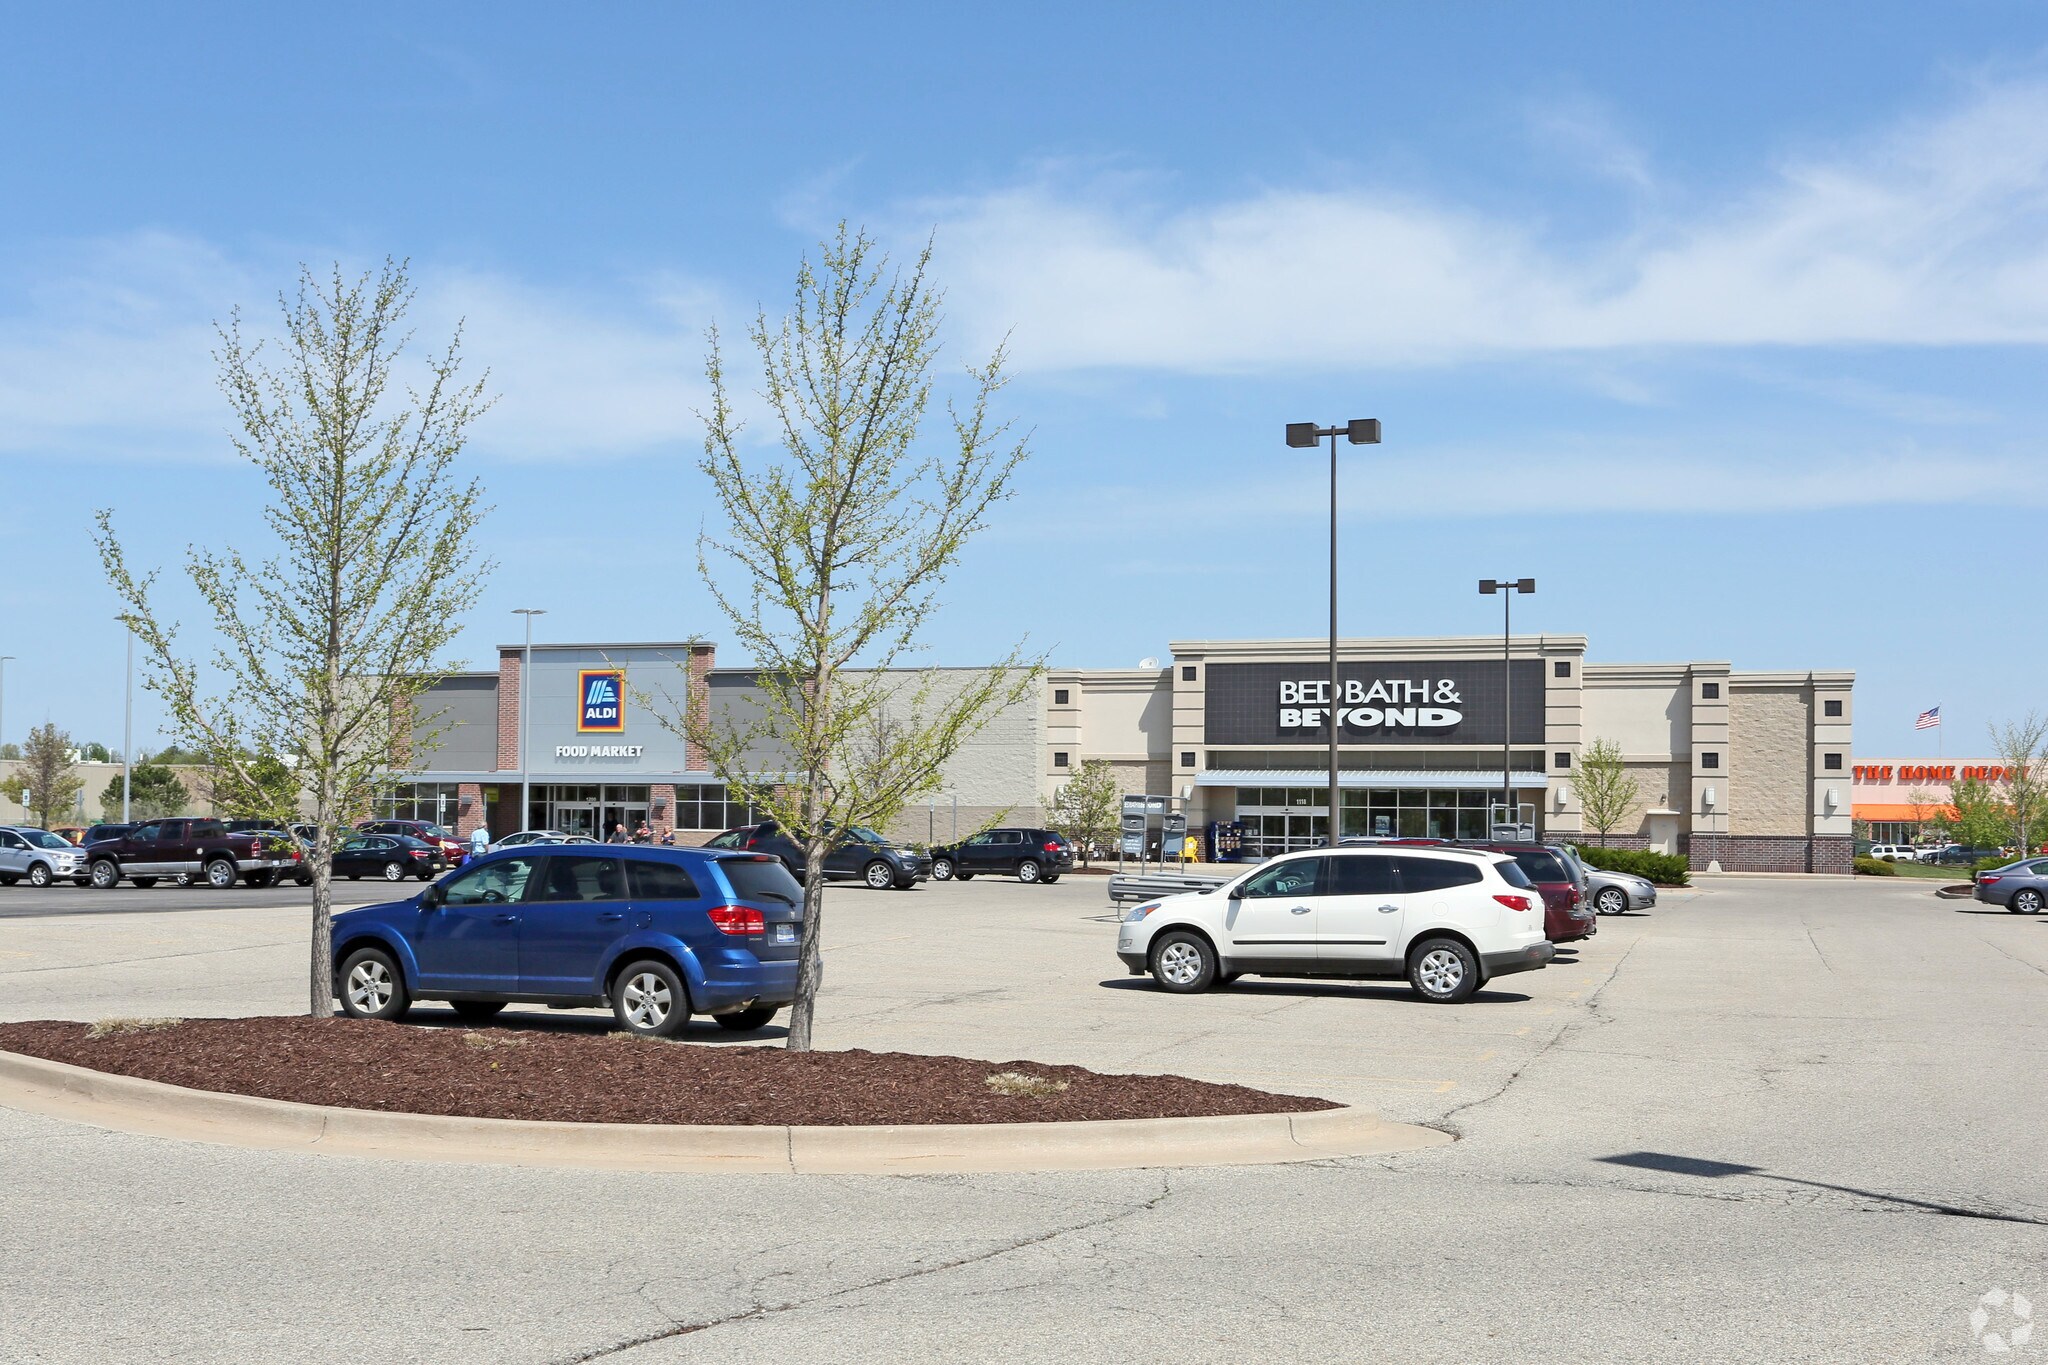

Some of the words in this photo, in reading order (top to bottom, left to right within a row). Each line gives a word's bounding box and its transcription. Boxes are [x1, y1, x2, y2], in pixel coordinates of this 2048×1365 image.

[1279, 680, 1342, 704] BED
[1345, 679, 1430, 704] BATH
[1433, 679, 1463, 704] &
[585, 707, 617, 719] ALDI
[1279, 707, 1464, 728] BEYOND
[555, 745, 588, 757] FOOD
[590, 745, 643, 757] MARKET
[1852, 765, 1894, 780] THE
[1899, 765, 1957, 780] HOME
